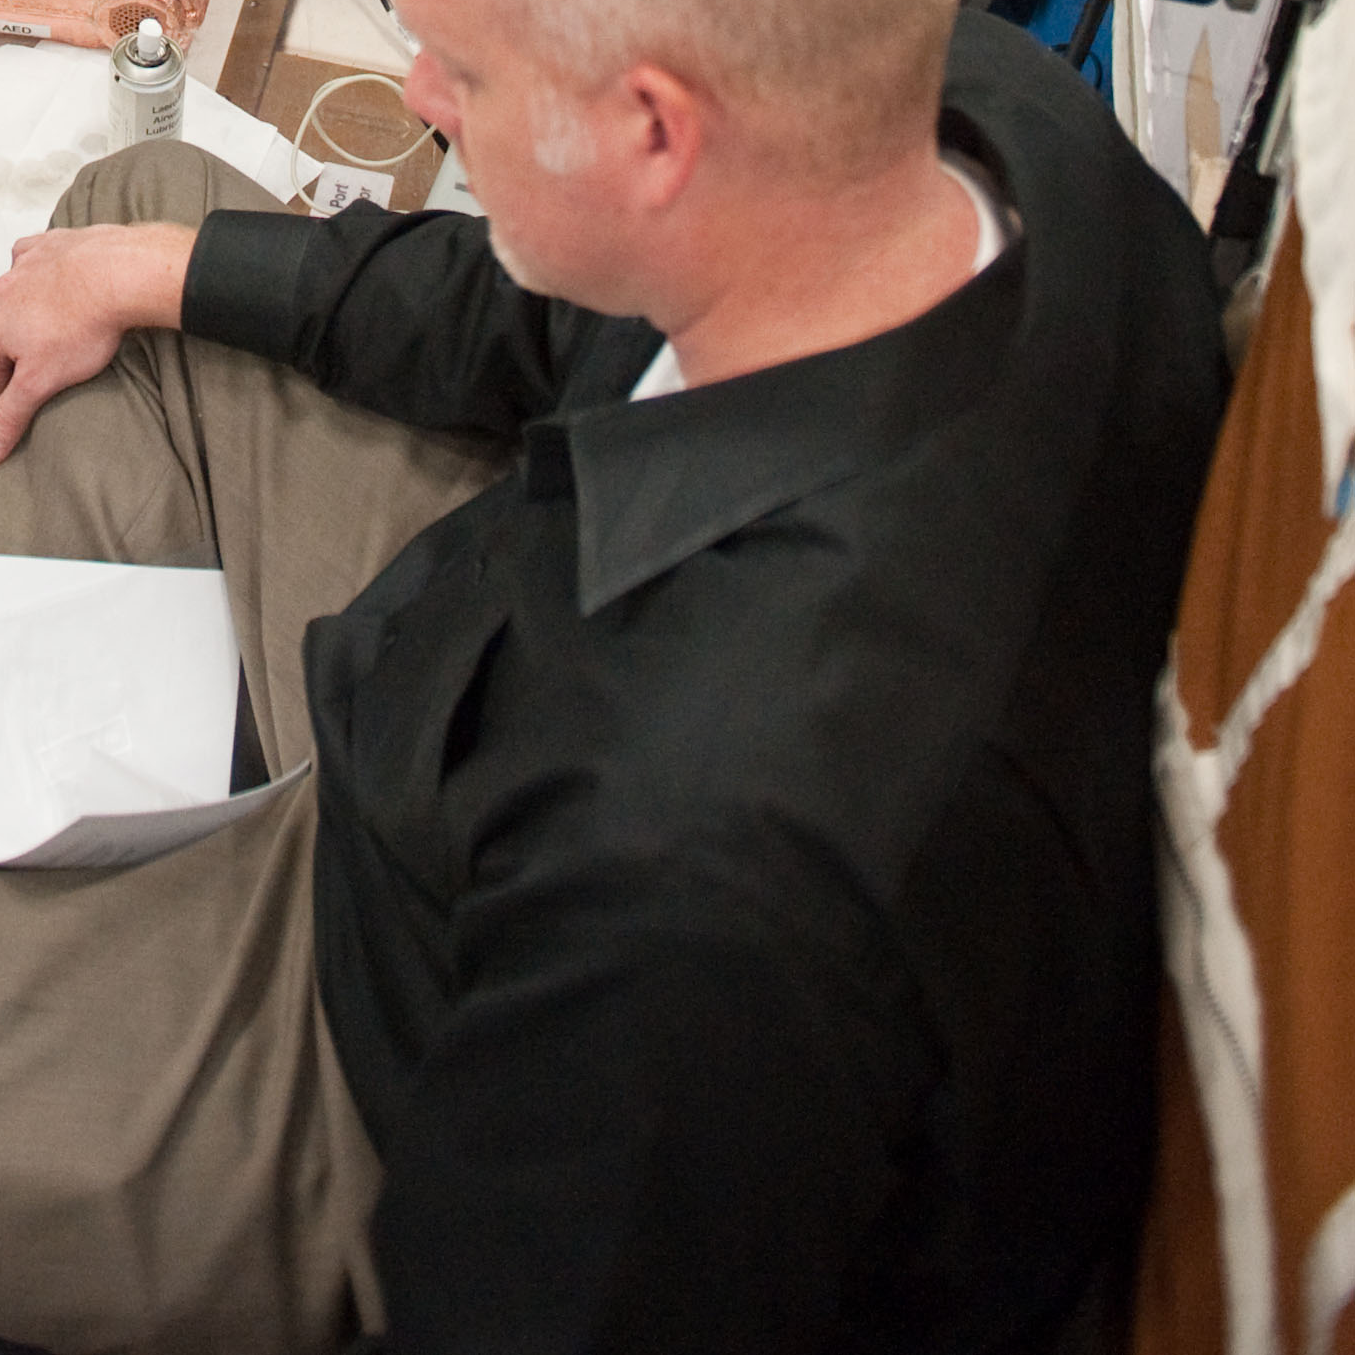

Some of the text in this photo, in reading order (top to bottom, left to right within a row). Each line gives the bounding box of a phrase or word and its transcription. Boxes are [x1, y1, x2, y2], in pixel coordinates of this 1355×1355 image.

[2, 24, 32, 34] AED
[153, 111, 179, 125] Airw
[329, 183, 349, 209] Port
[359, 187, 373, 201] or
